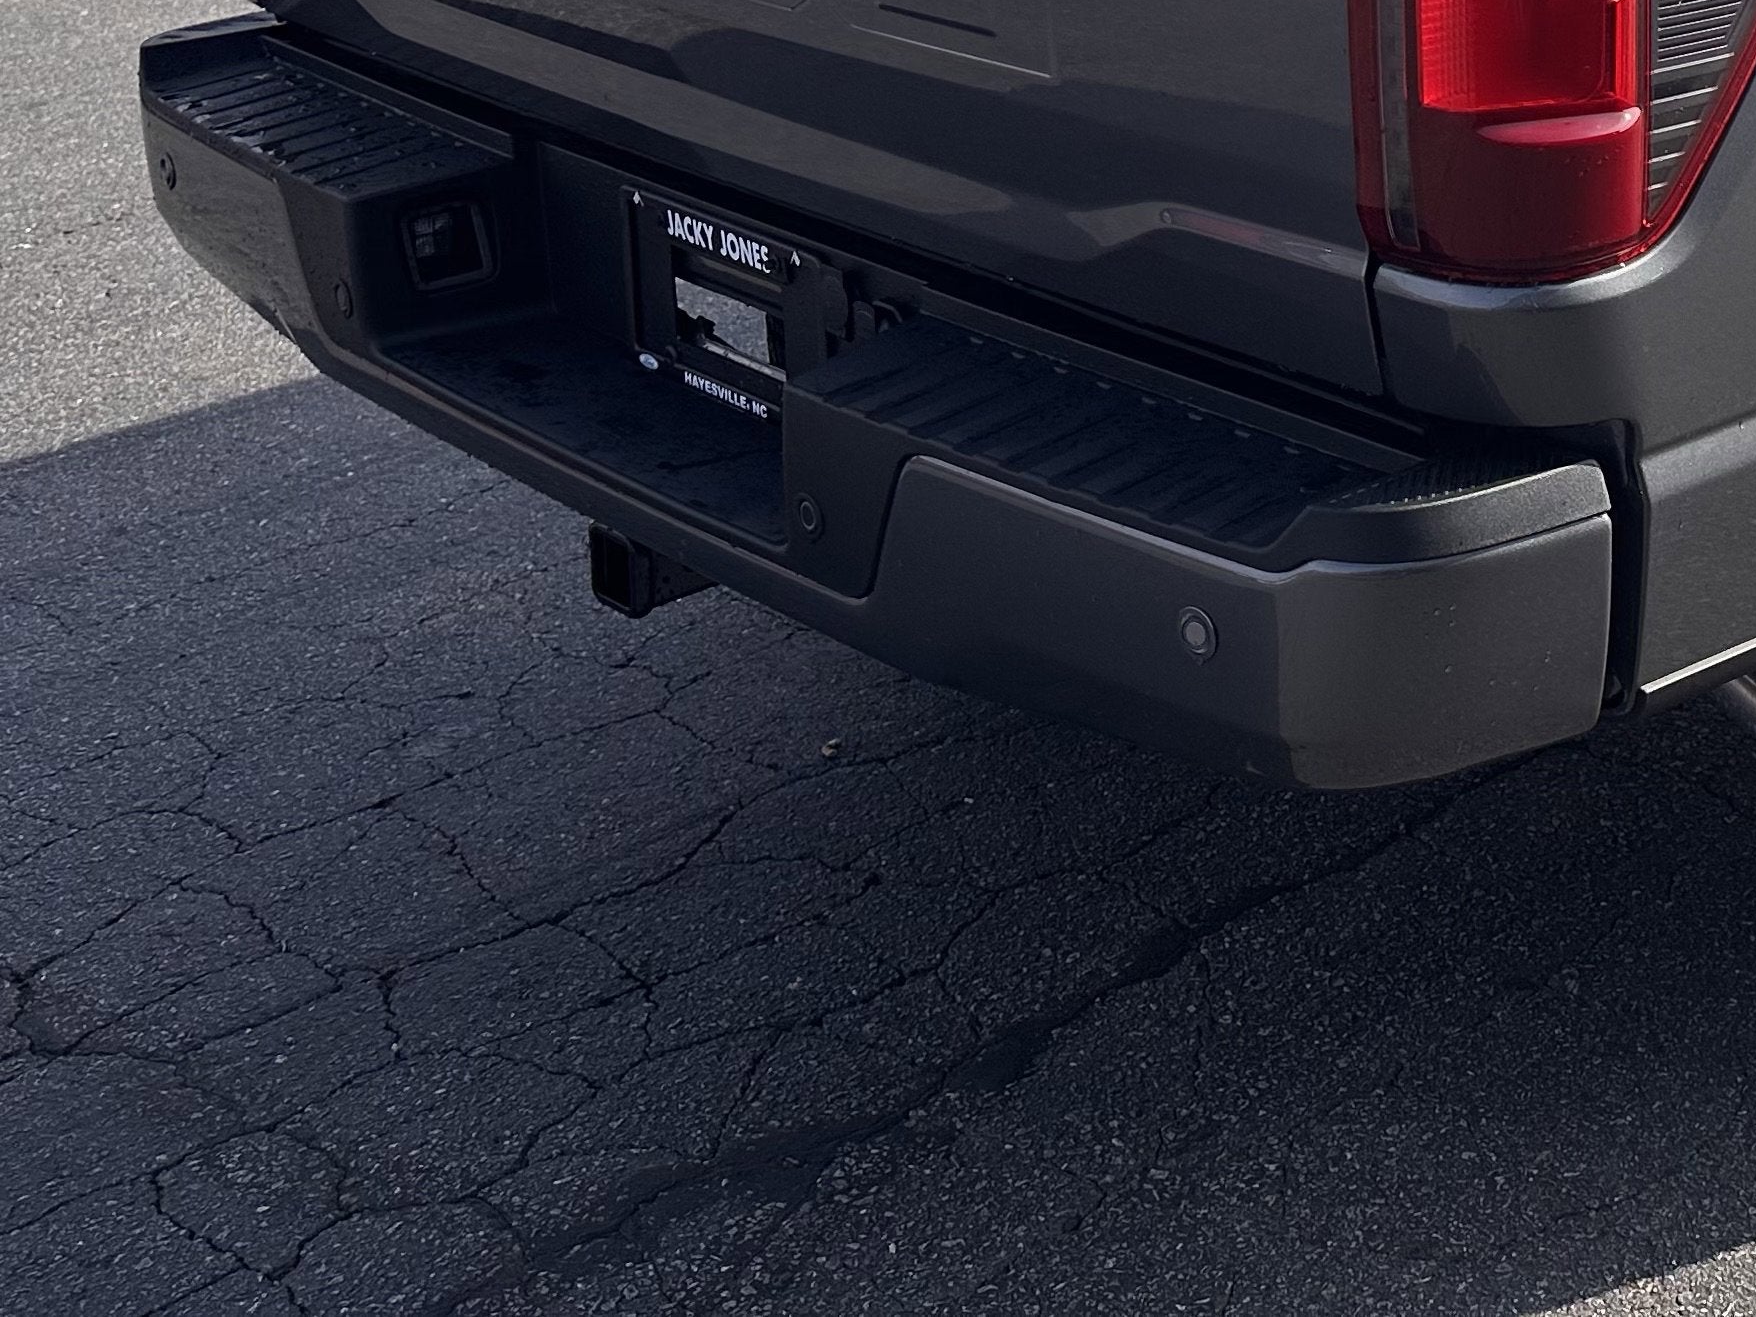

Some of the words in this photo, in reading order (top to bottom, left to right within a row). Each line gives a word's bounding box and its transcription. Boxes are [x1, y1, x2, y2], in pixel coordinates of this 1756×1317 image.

[666, 208, 715, 252] JACKY
[719, 229, 772, 274] JONES
[684, 371, 750, 411] HAYESVILLE,
[751, 400, 768, 419] NC
